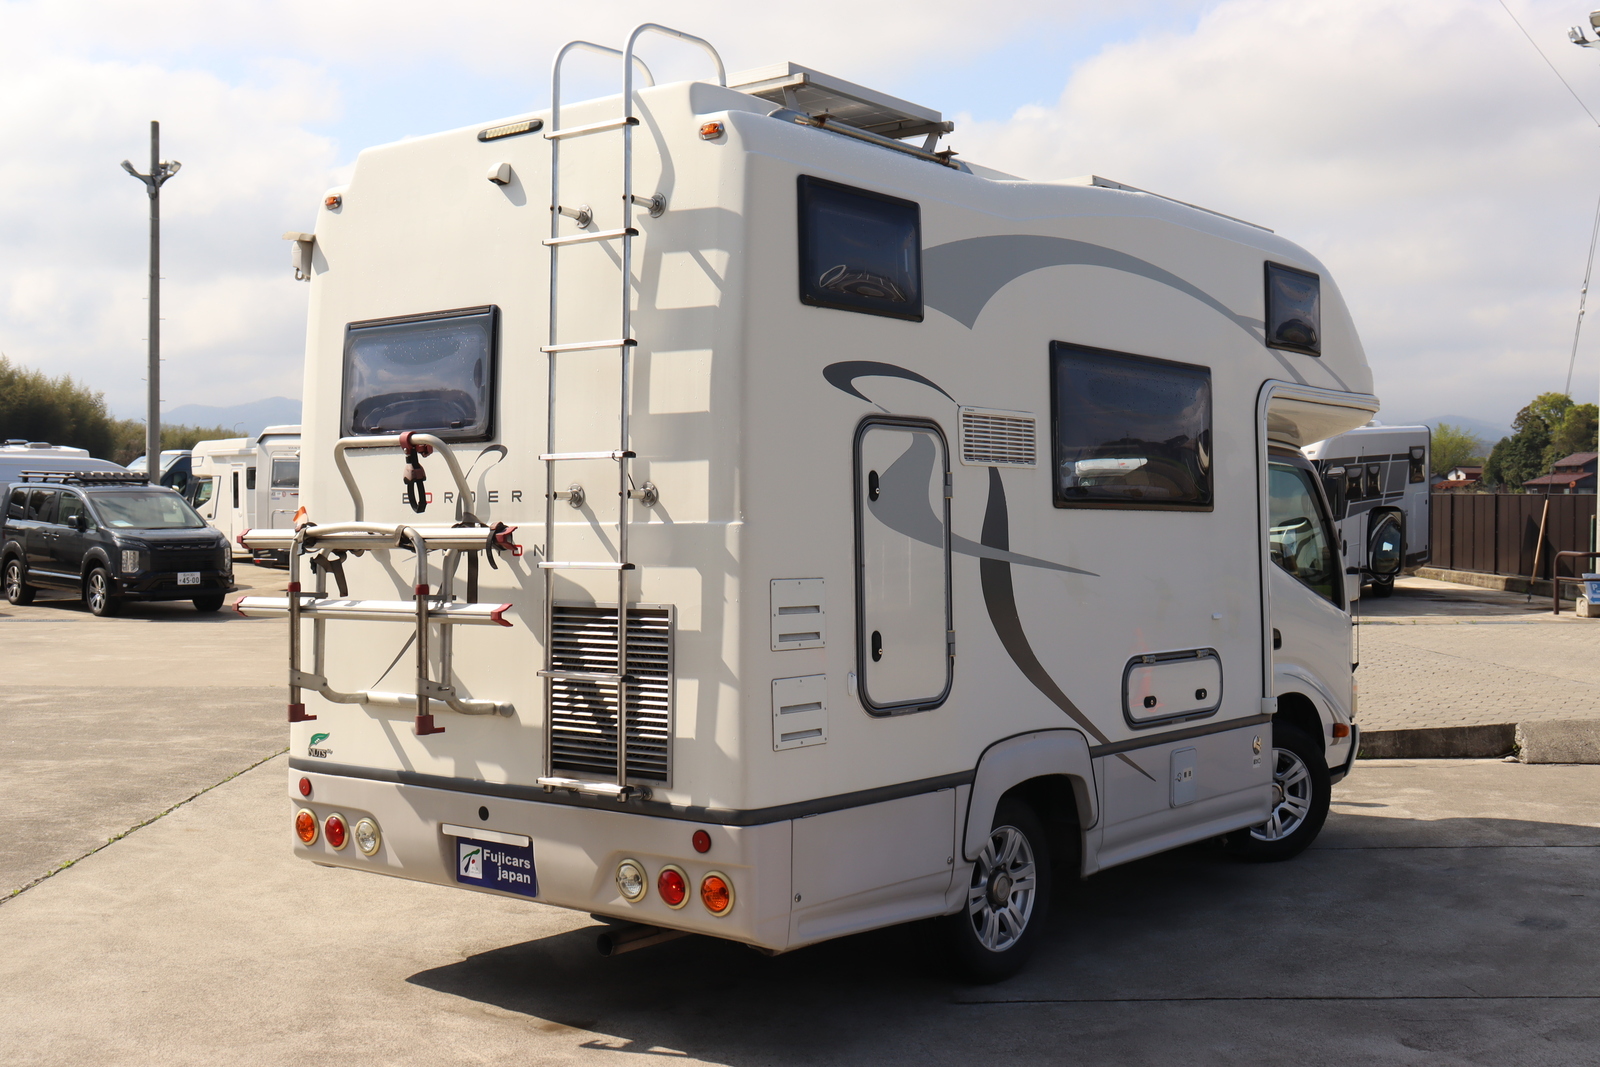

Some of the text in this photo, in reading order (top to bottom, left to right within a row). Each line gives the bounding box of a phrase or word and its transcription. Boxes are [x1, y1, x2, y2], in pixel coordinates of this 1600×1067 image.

[308, 747, 327, 758] NUTS
[483, 848, 531, 869] Fujicars
[497, 866, 531, 884] japan
